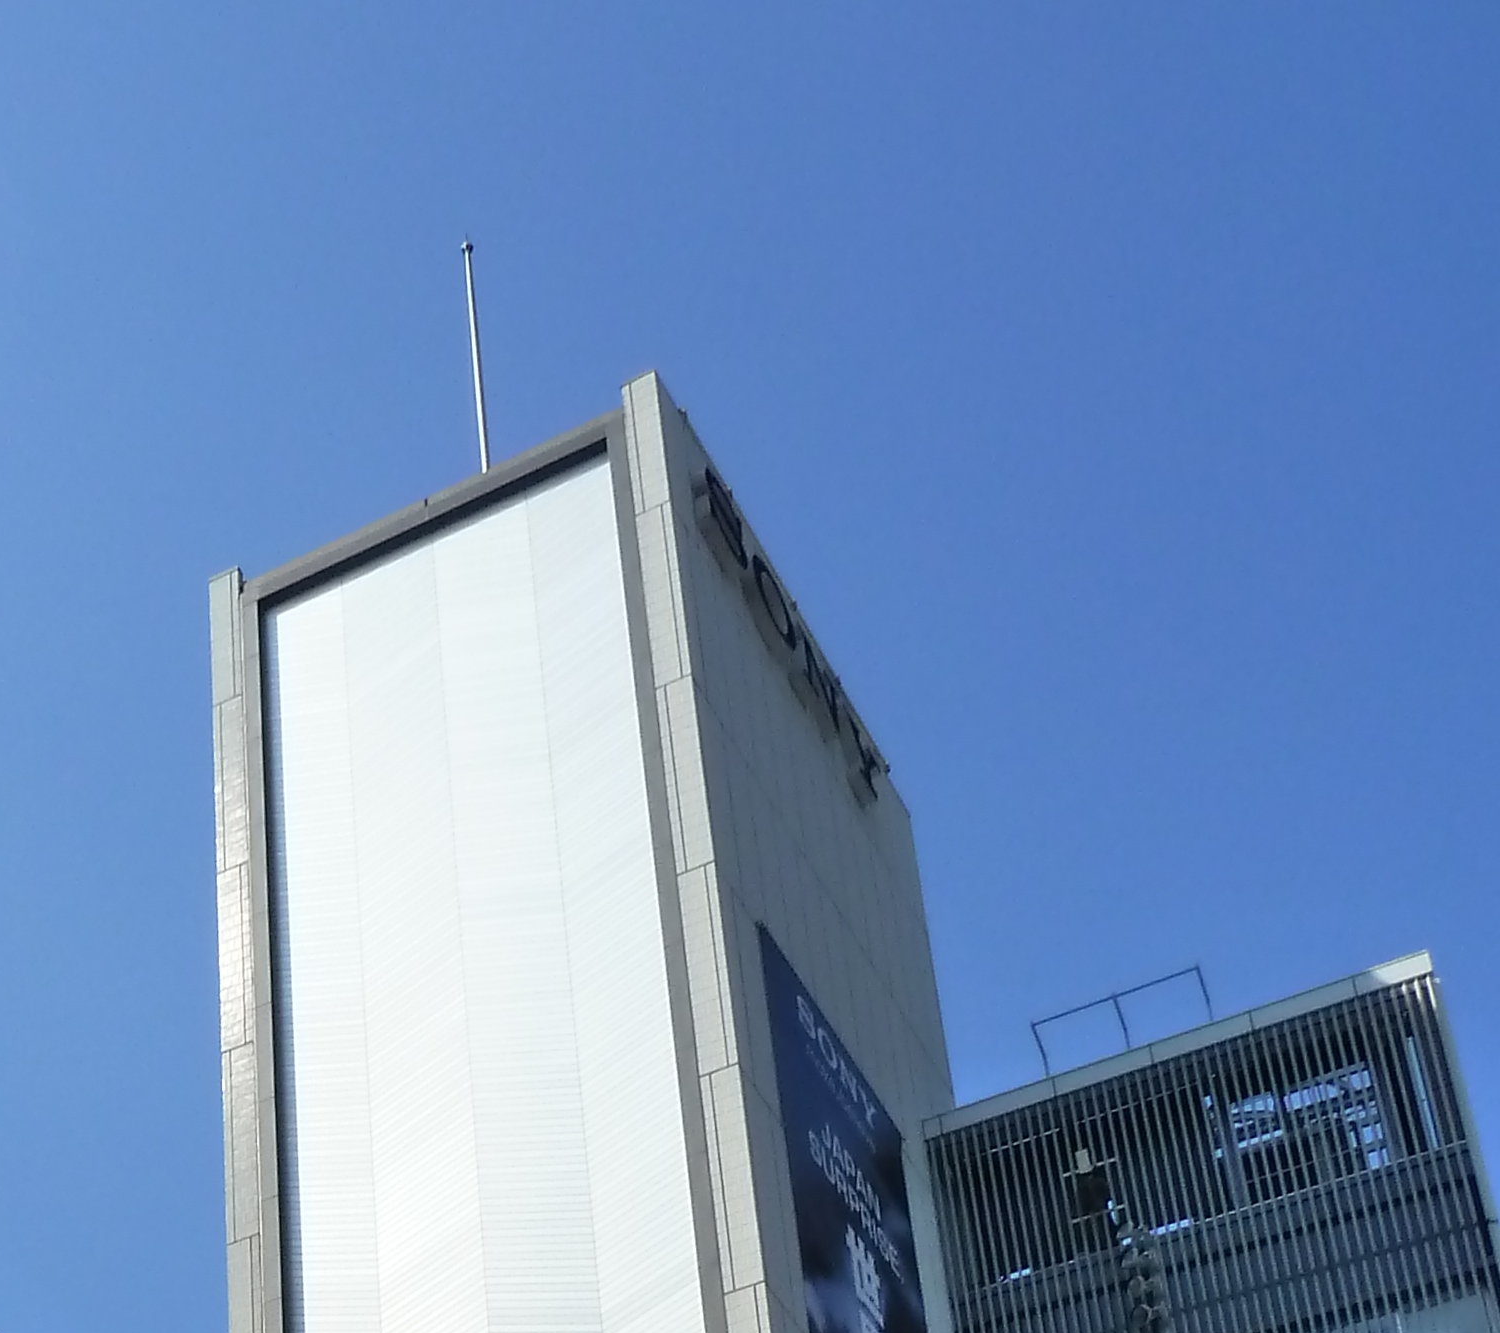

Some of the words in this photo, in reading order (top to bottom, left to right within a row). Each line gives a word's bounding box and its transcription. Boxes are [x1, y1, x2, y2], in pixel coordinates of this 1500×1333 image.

[703, 465, 884, 803] SONY
[796, 995, 877, 1130] SONY
[820, 1122, 882, 1222] JAPAN
